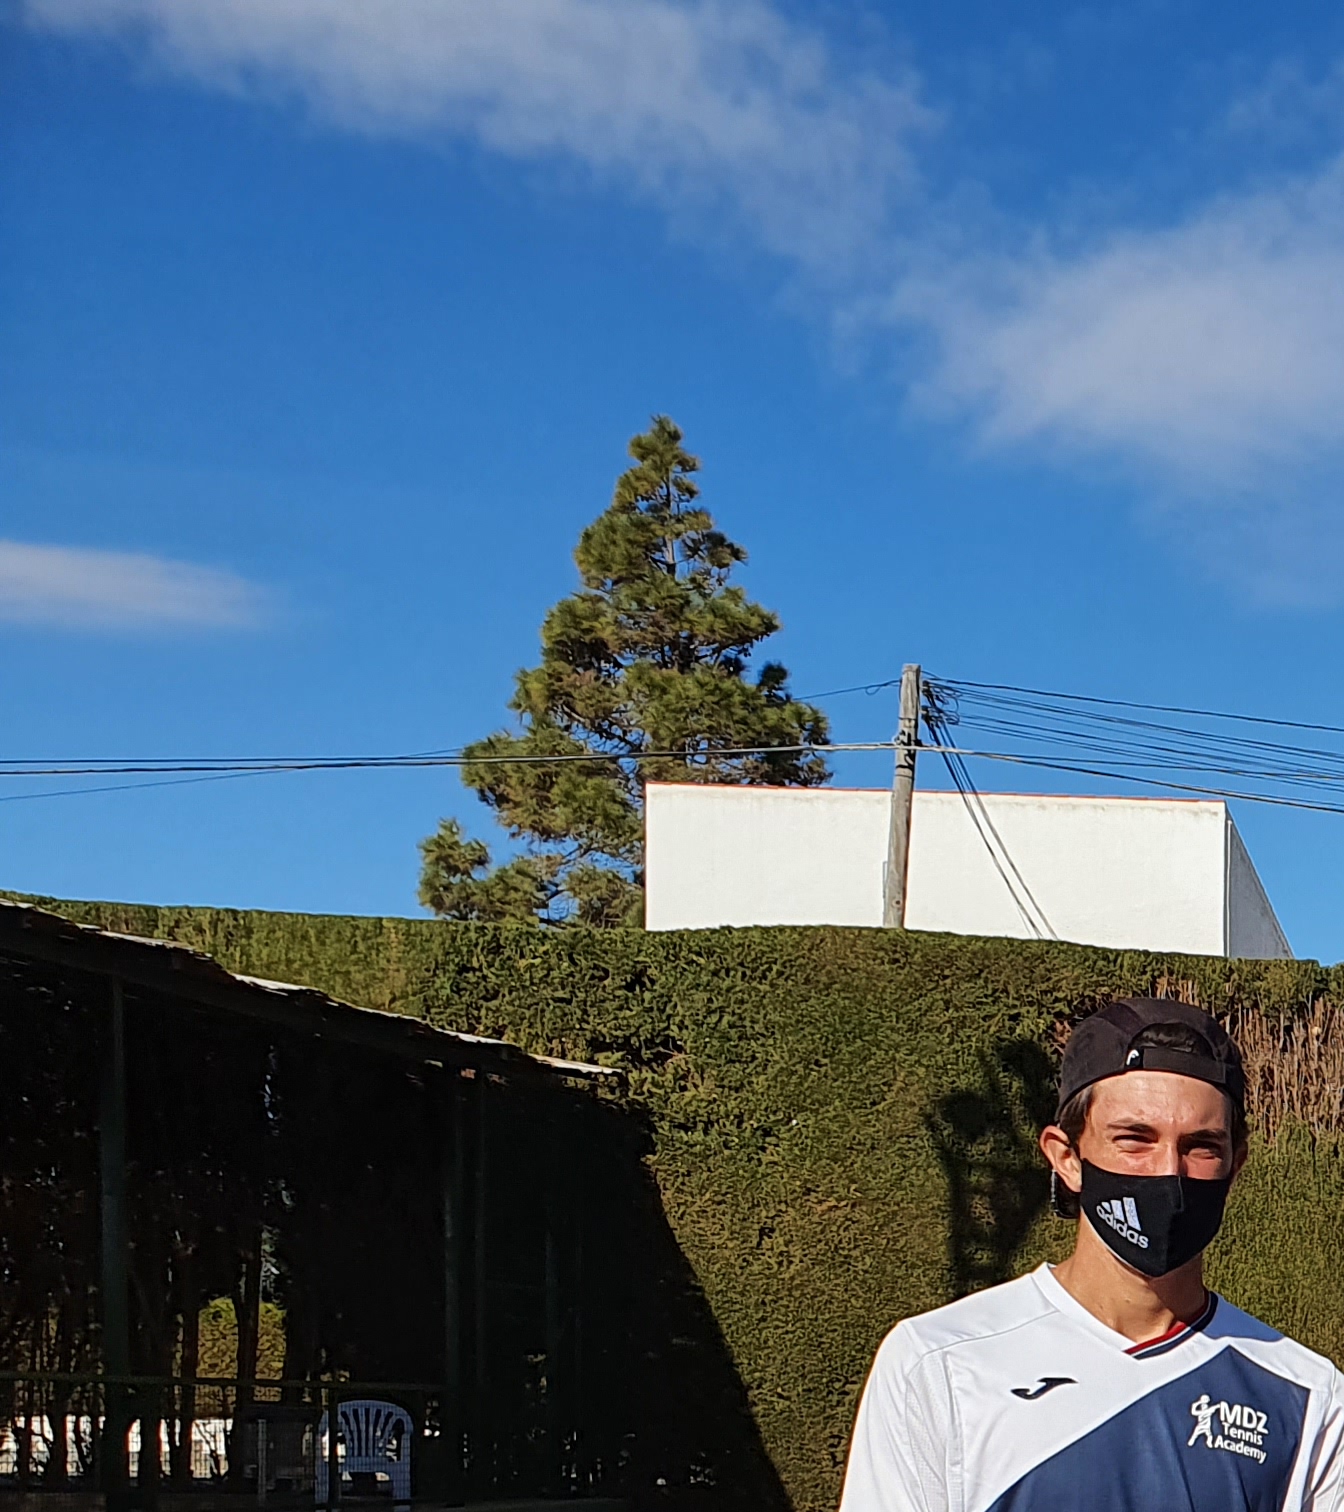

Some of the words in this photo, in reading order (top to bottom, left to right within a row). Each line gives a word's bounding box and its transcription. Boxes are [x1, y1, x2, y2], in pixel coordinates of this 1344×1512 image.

[1096, 1205, 1149, 1249] adidas
[1221, 1422, 1263, 1446] Tennis
[1214, 1435, 1267, 1464] Academy
